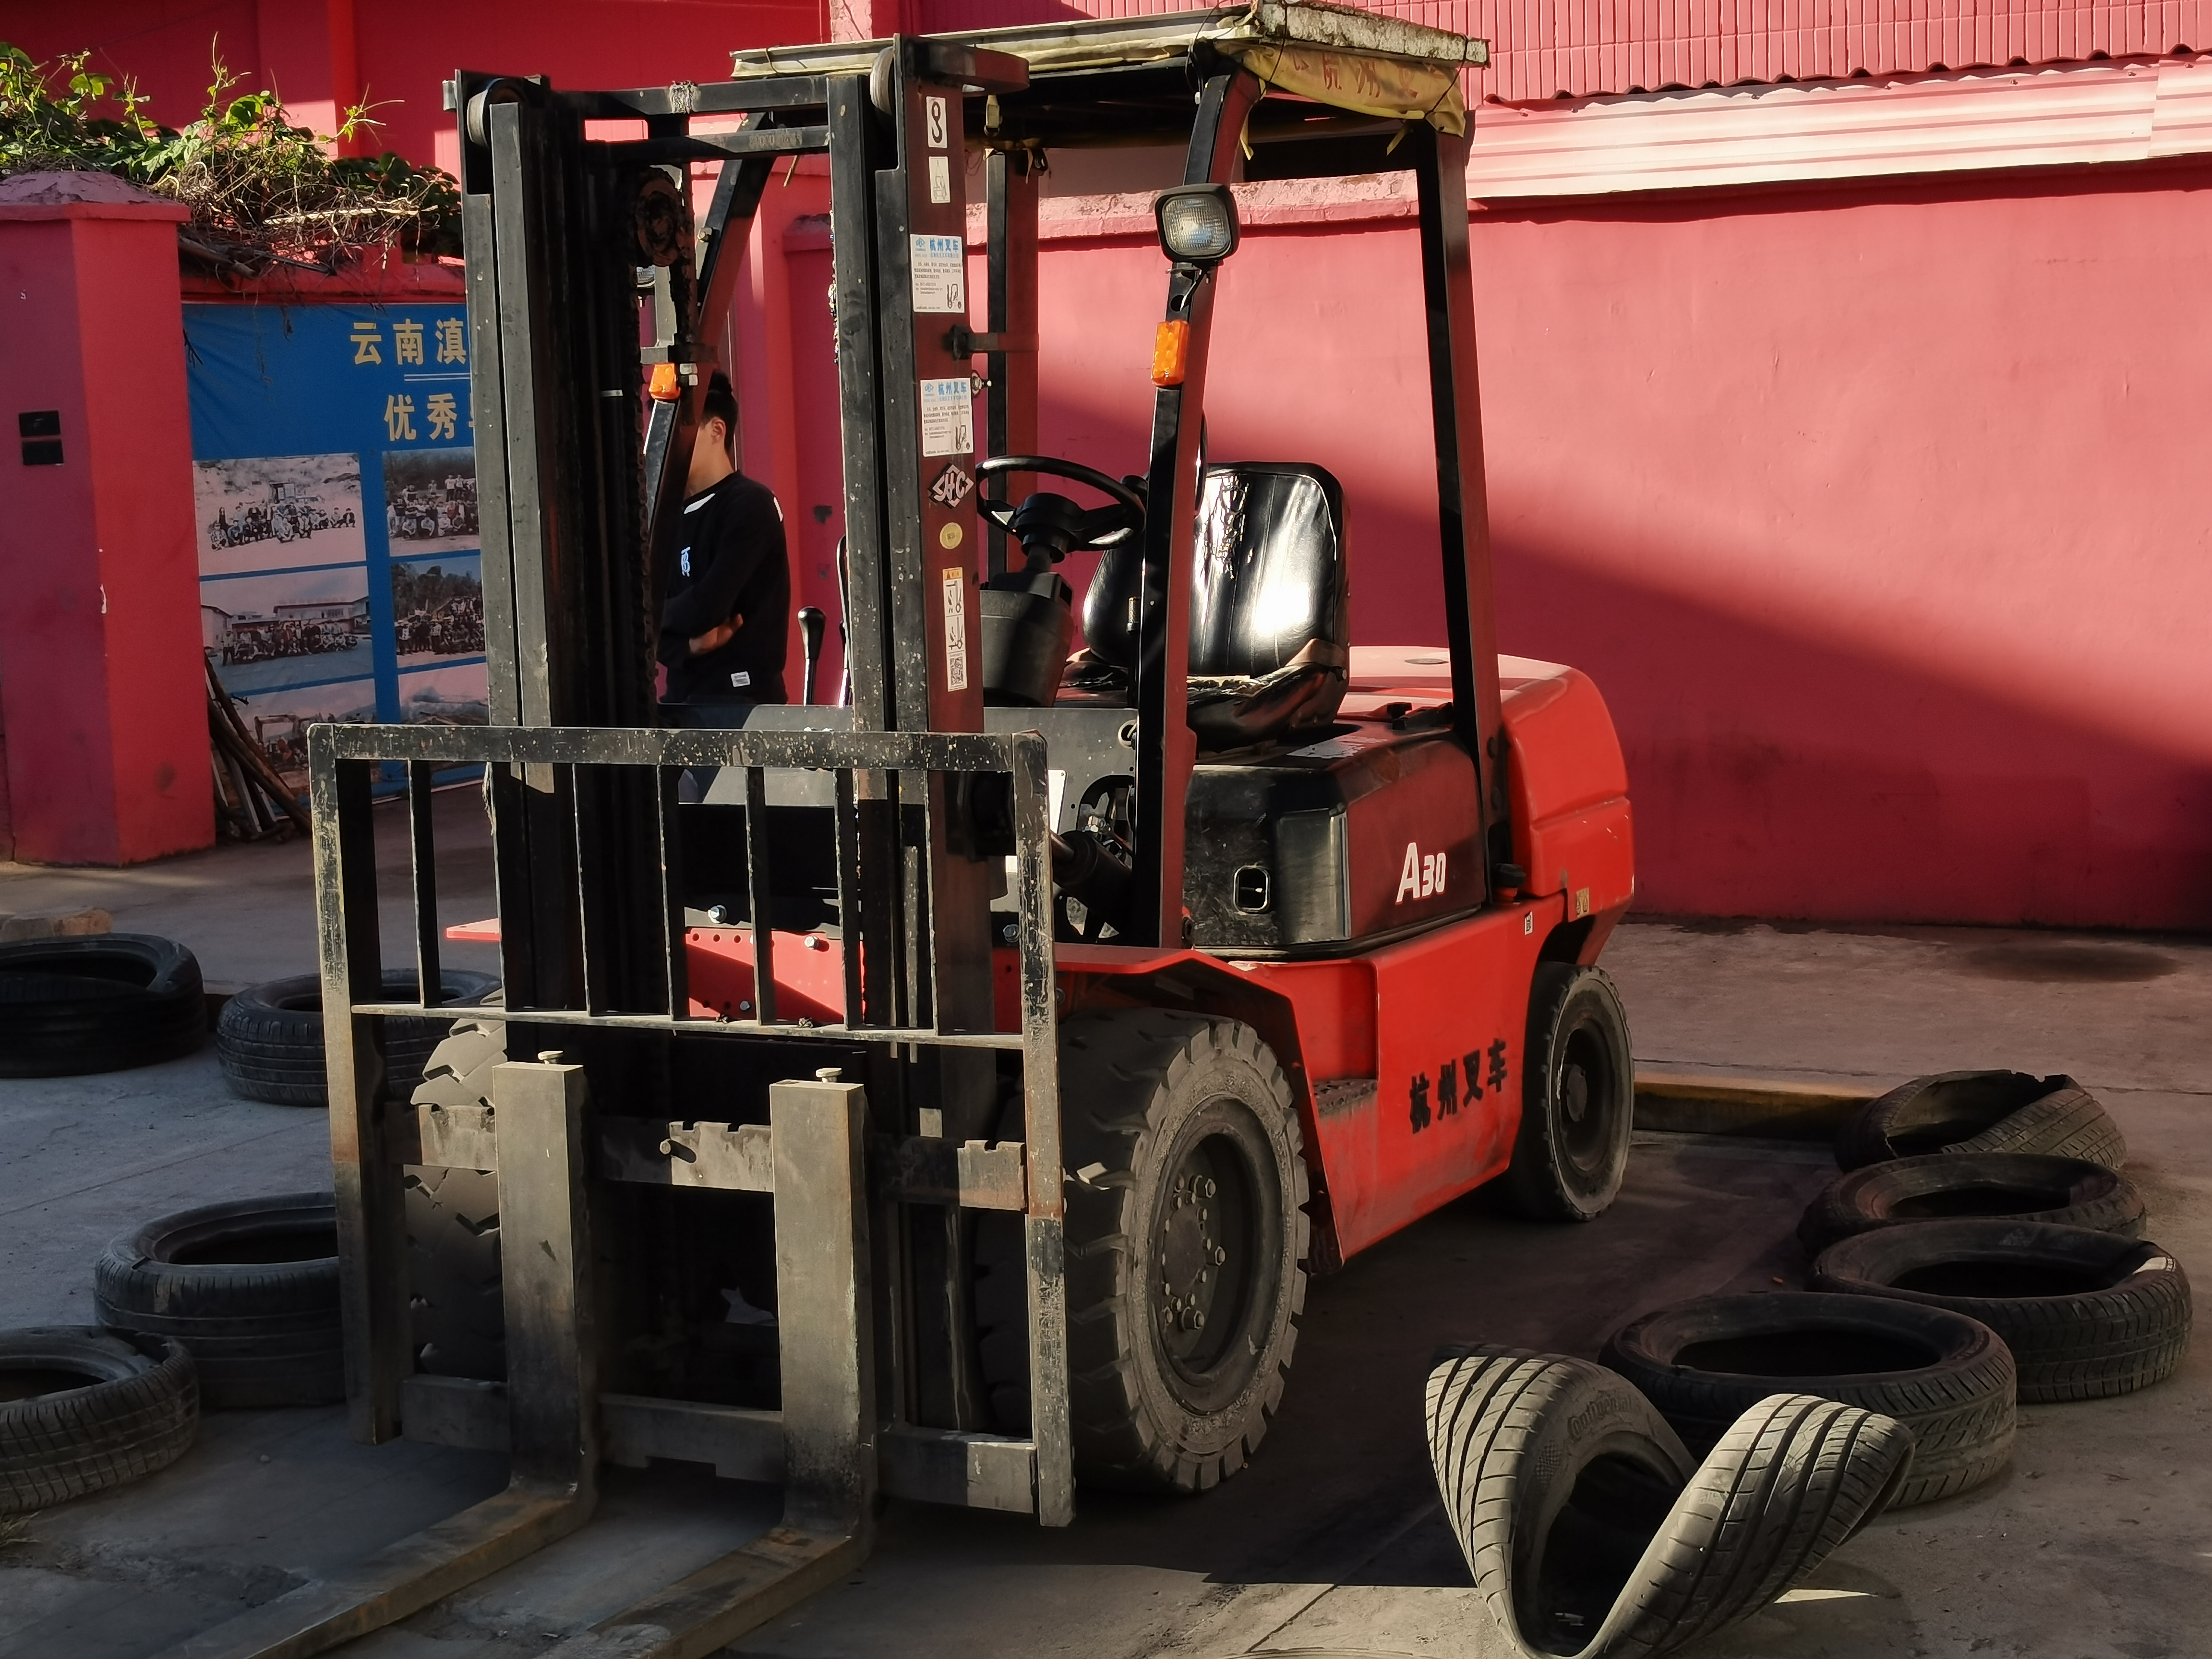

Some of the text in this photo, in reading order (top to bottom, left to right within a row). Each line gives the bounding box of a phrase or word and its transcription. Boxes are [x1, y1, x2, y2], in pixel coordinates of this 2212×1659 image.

[350, 317, 468, 365] 云南滇
[384, 393, 475, 442] 优秀
[1395, 842, 1446, 905] A30
[1409, 1038, 1508, 1134] 杭州叉车
[1567, 1395, 1633, 1443] Continental
